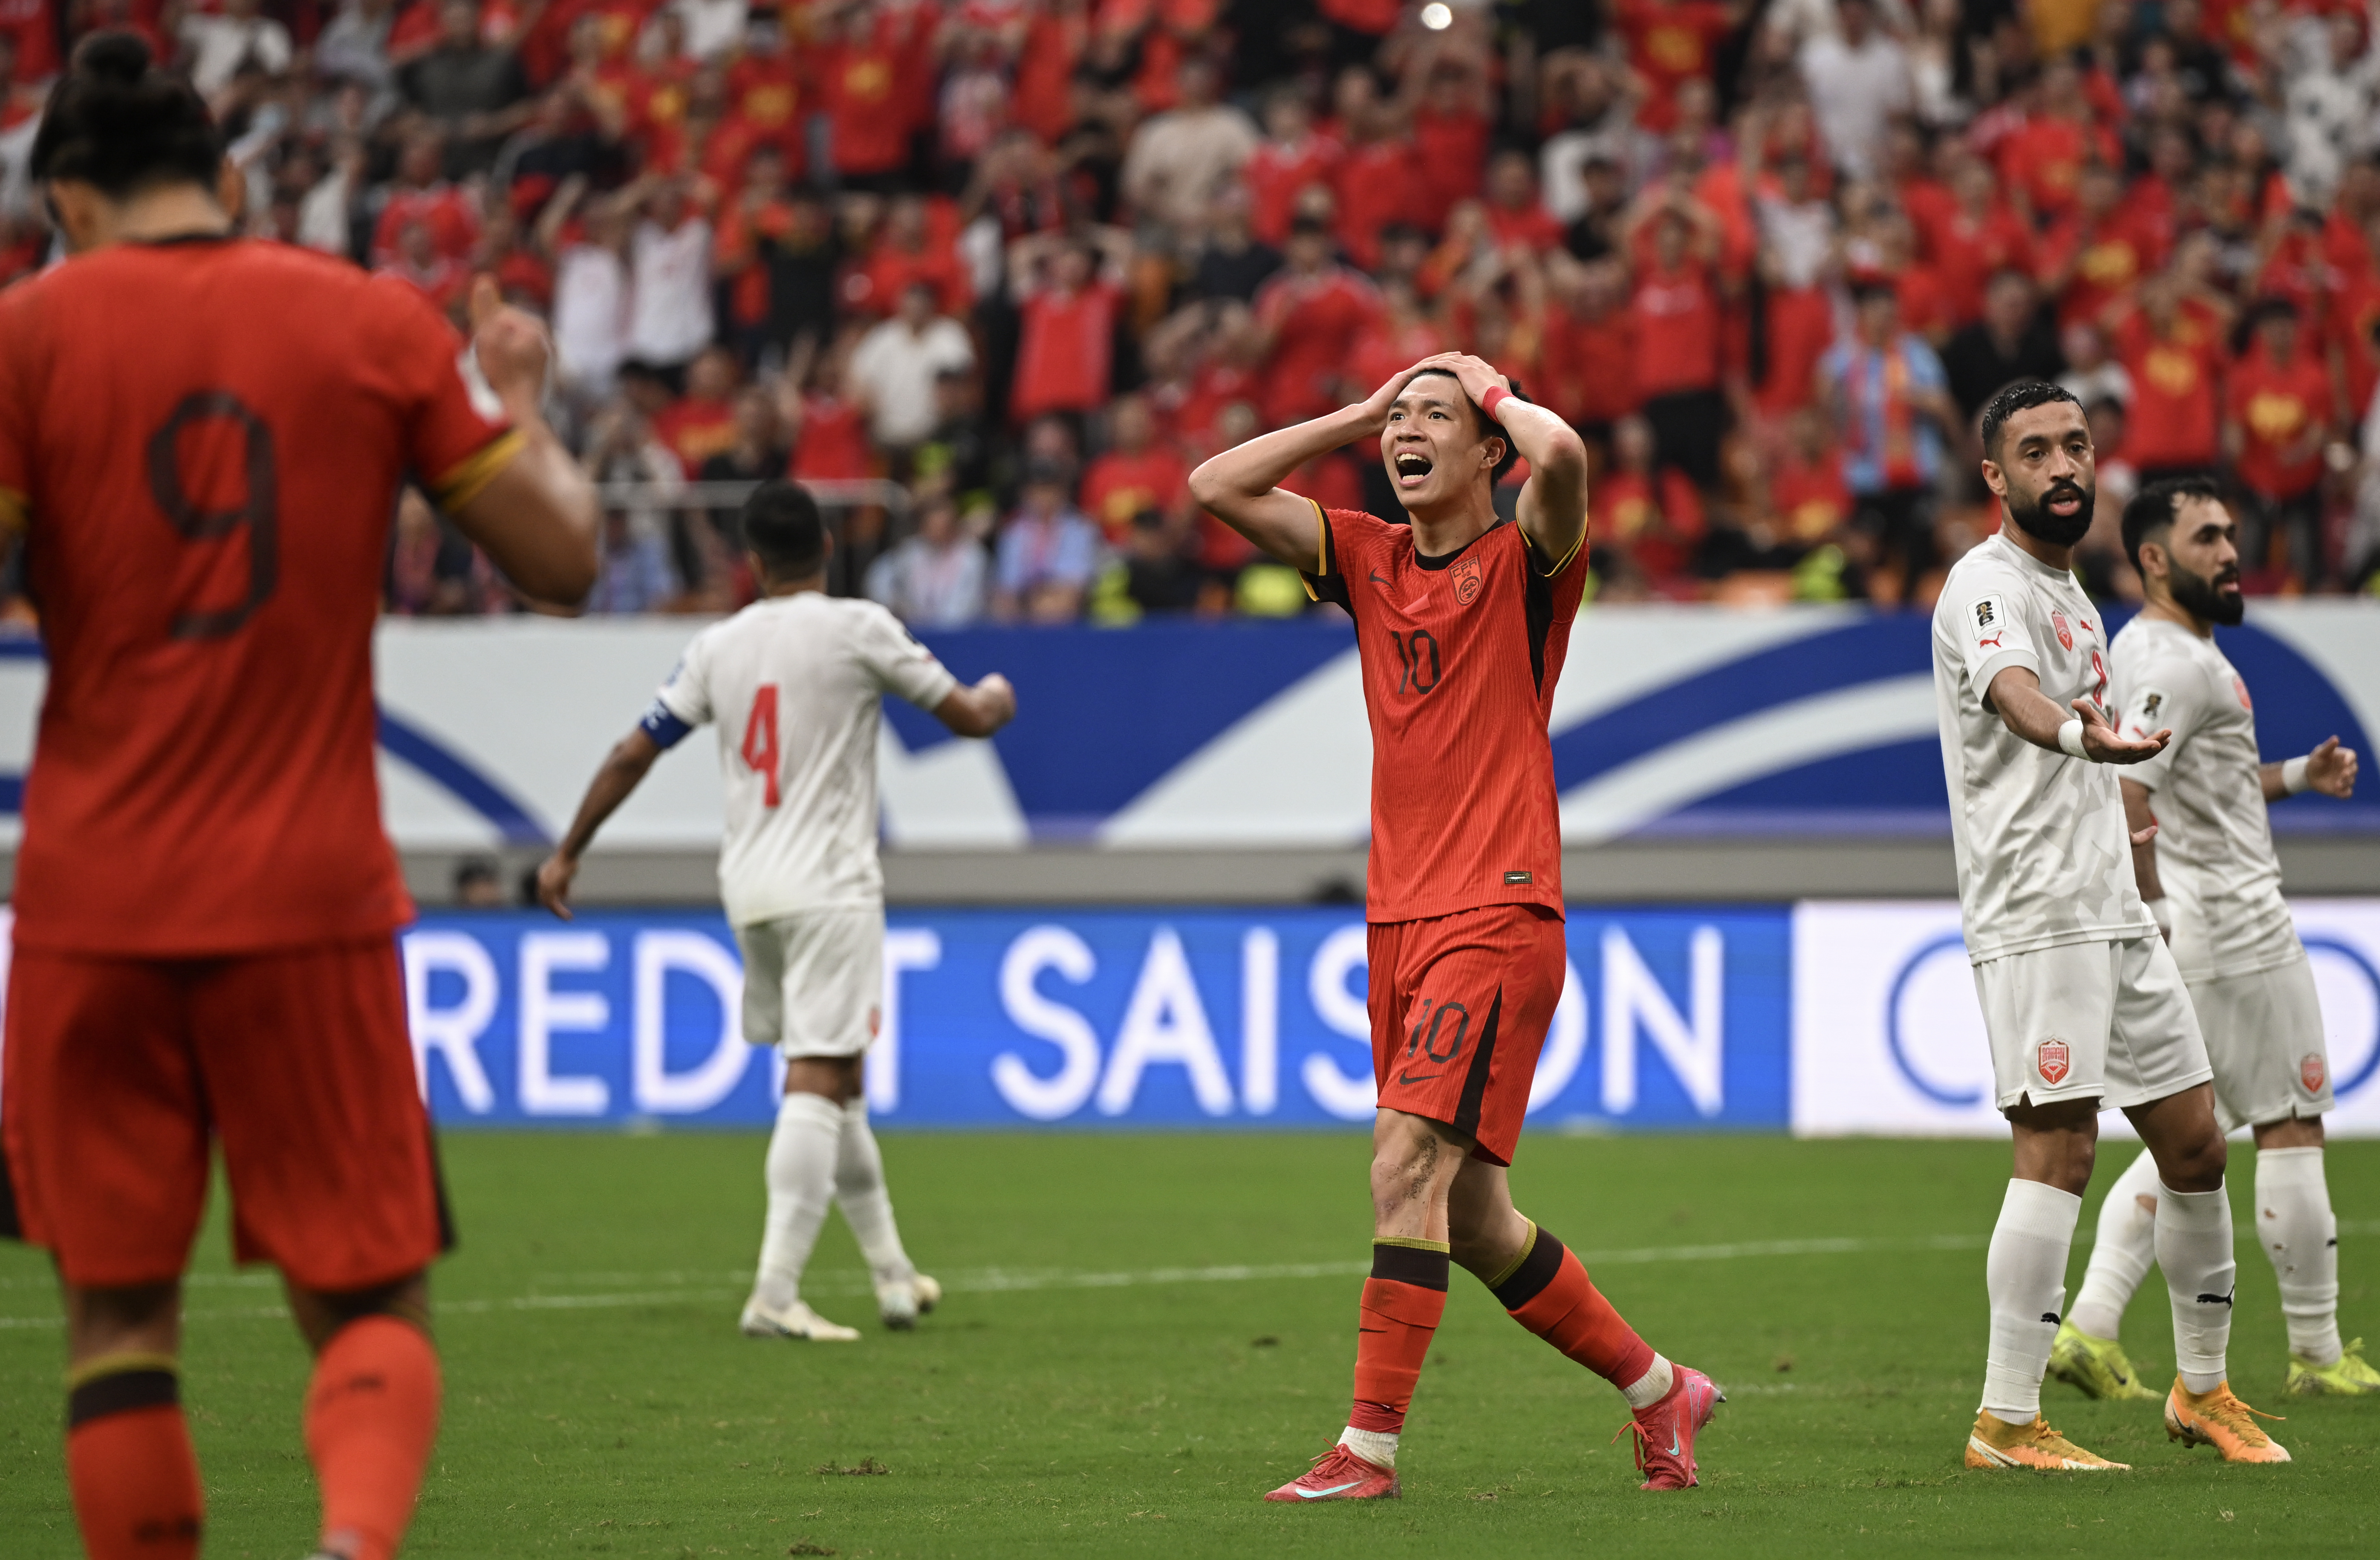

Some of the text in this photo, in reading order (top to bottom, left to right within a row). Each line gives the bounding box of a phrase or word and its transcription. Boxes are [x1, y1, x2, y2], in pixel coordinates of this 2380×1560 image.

[148, 390, 279, 640] 9
[1453, 558, 1477, 578] CFA
[1392, 629, 1441, 695] 10
[742, 683, 780, 808] 4
[990, 925, 1724, 1121] SAISN
[1407, 998, 1470, 1064] 10
